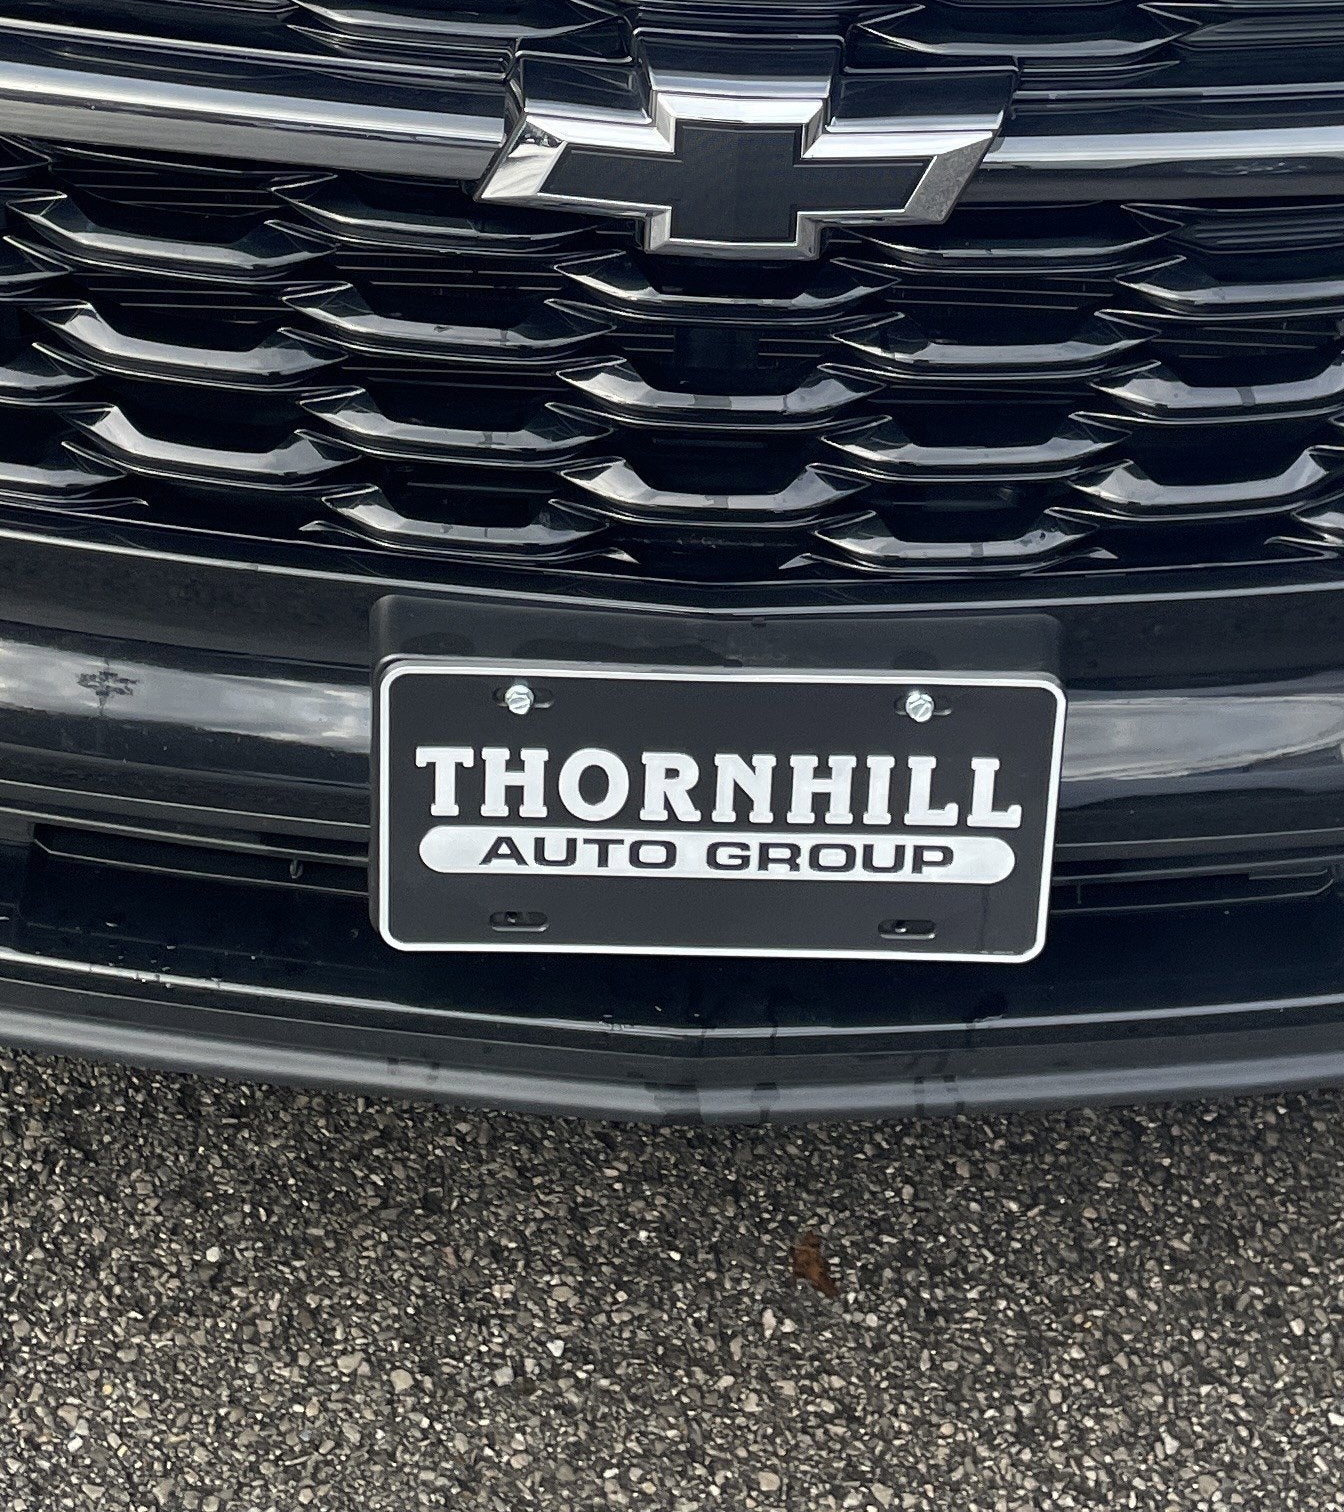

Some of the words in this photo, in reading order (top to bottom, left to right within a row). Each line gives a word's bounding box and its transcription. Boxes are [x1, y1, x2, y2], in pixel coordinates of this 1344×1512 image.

[415, 745, 1023, 829] THORNHILL
[478, 835, 679, 872] AUTO
[705, 841, 956, 875] GROUP
